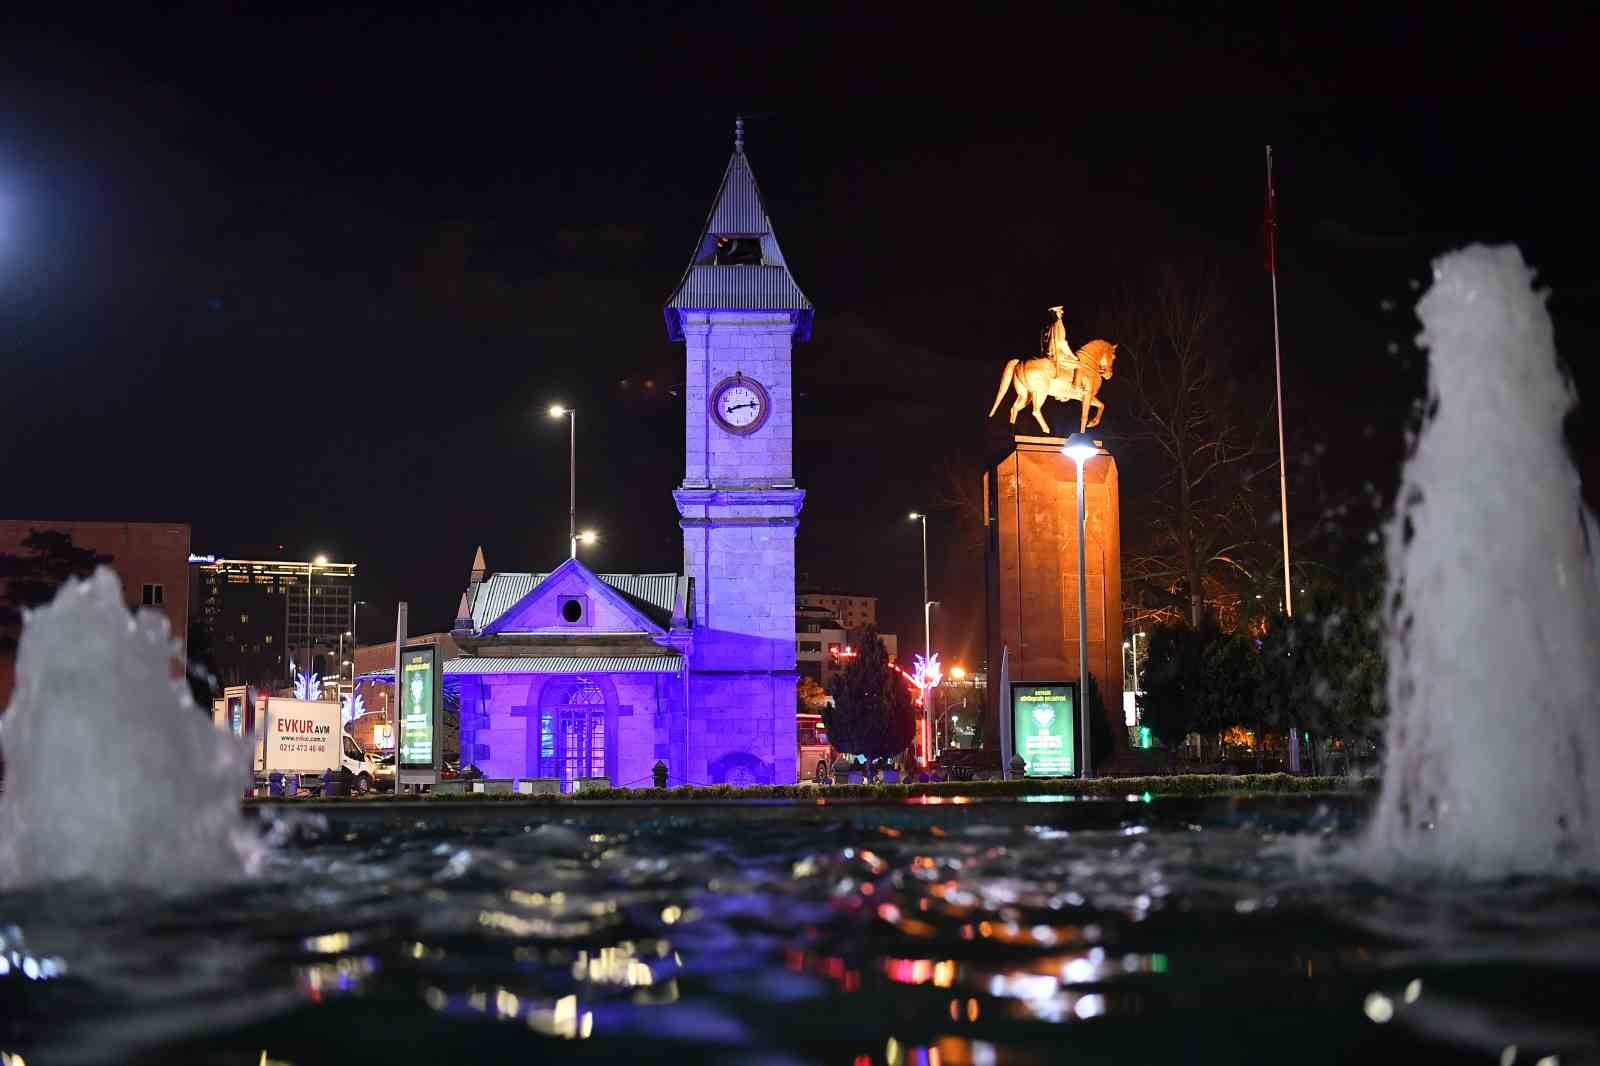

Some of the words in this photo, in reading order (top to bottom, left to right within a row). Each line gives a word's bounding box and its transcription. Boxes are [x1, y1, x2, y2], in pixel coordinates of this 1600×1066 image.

[278, 718, 314, 734] EVKUR
[315, 726, 330, 735] AVM
[280, 744, 295, 752] 0212
